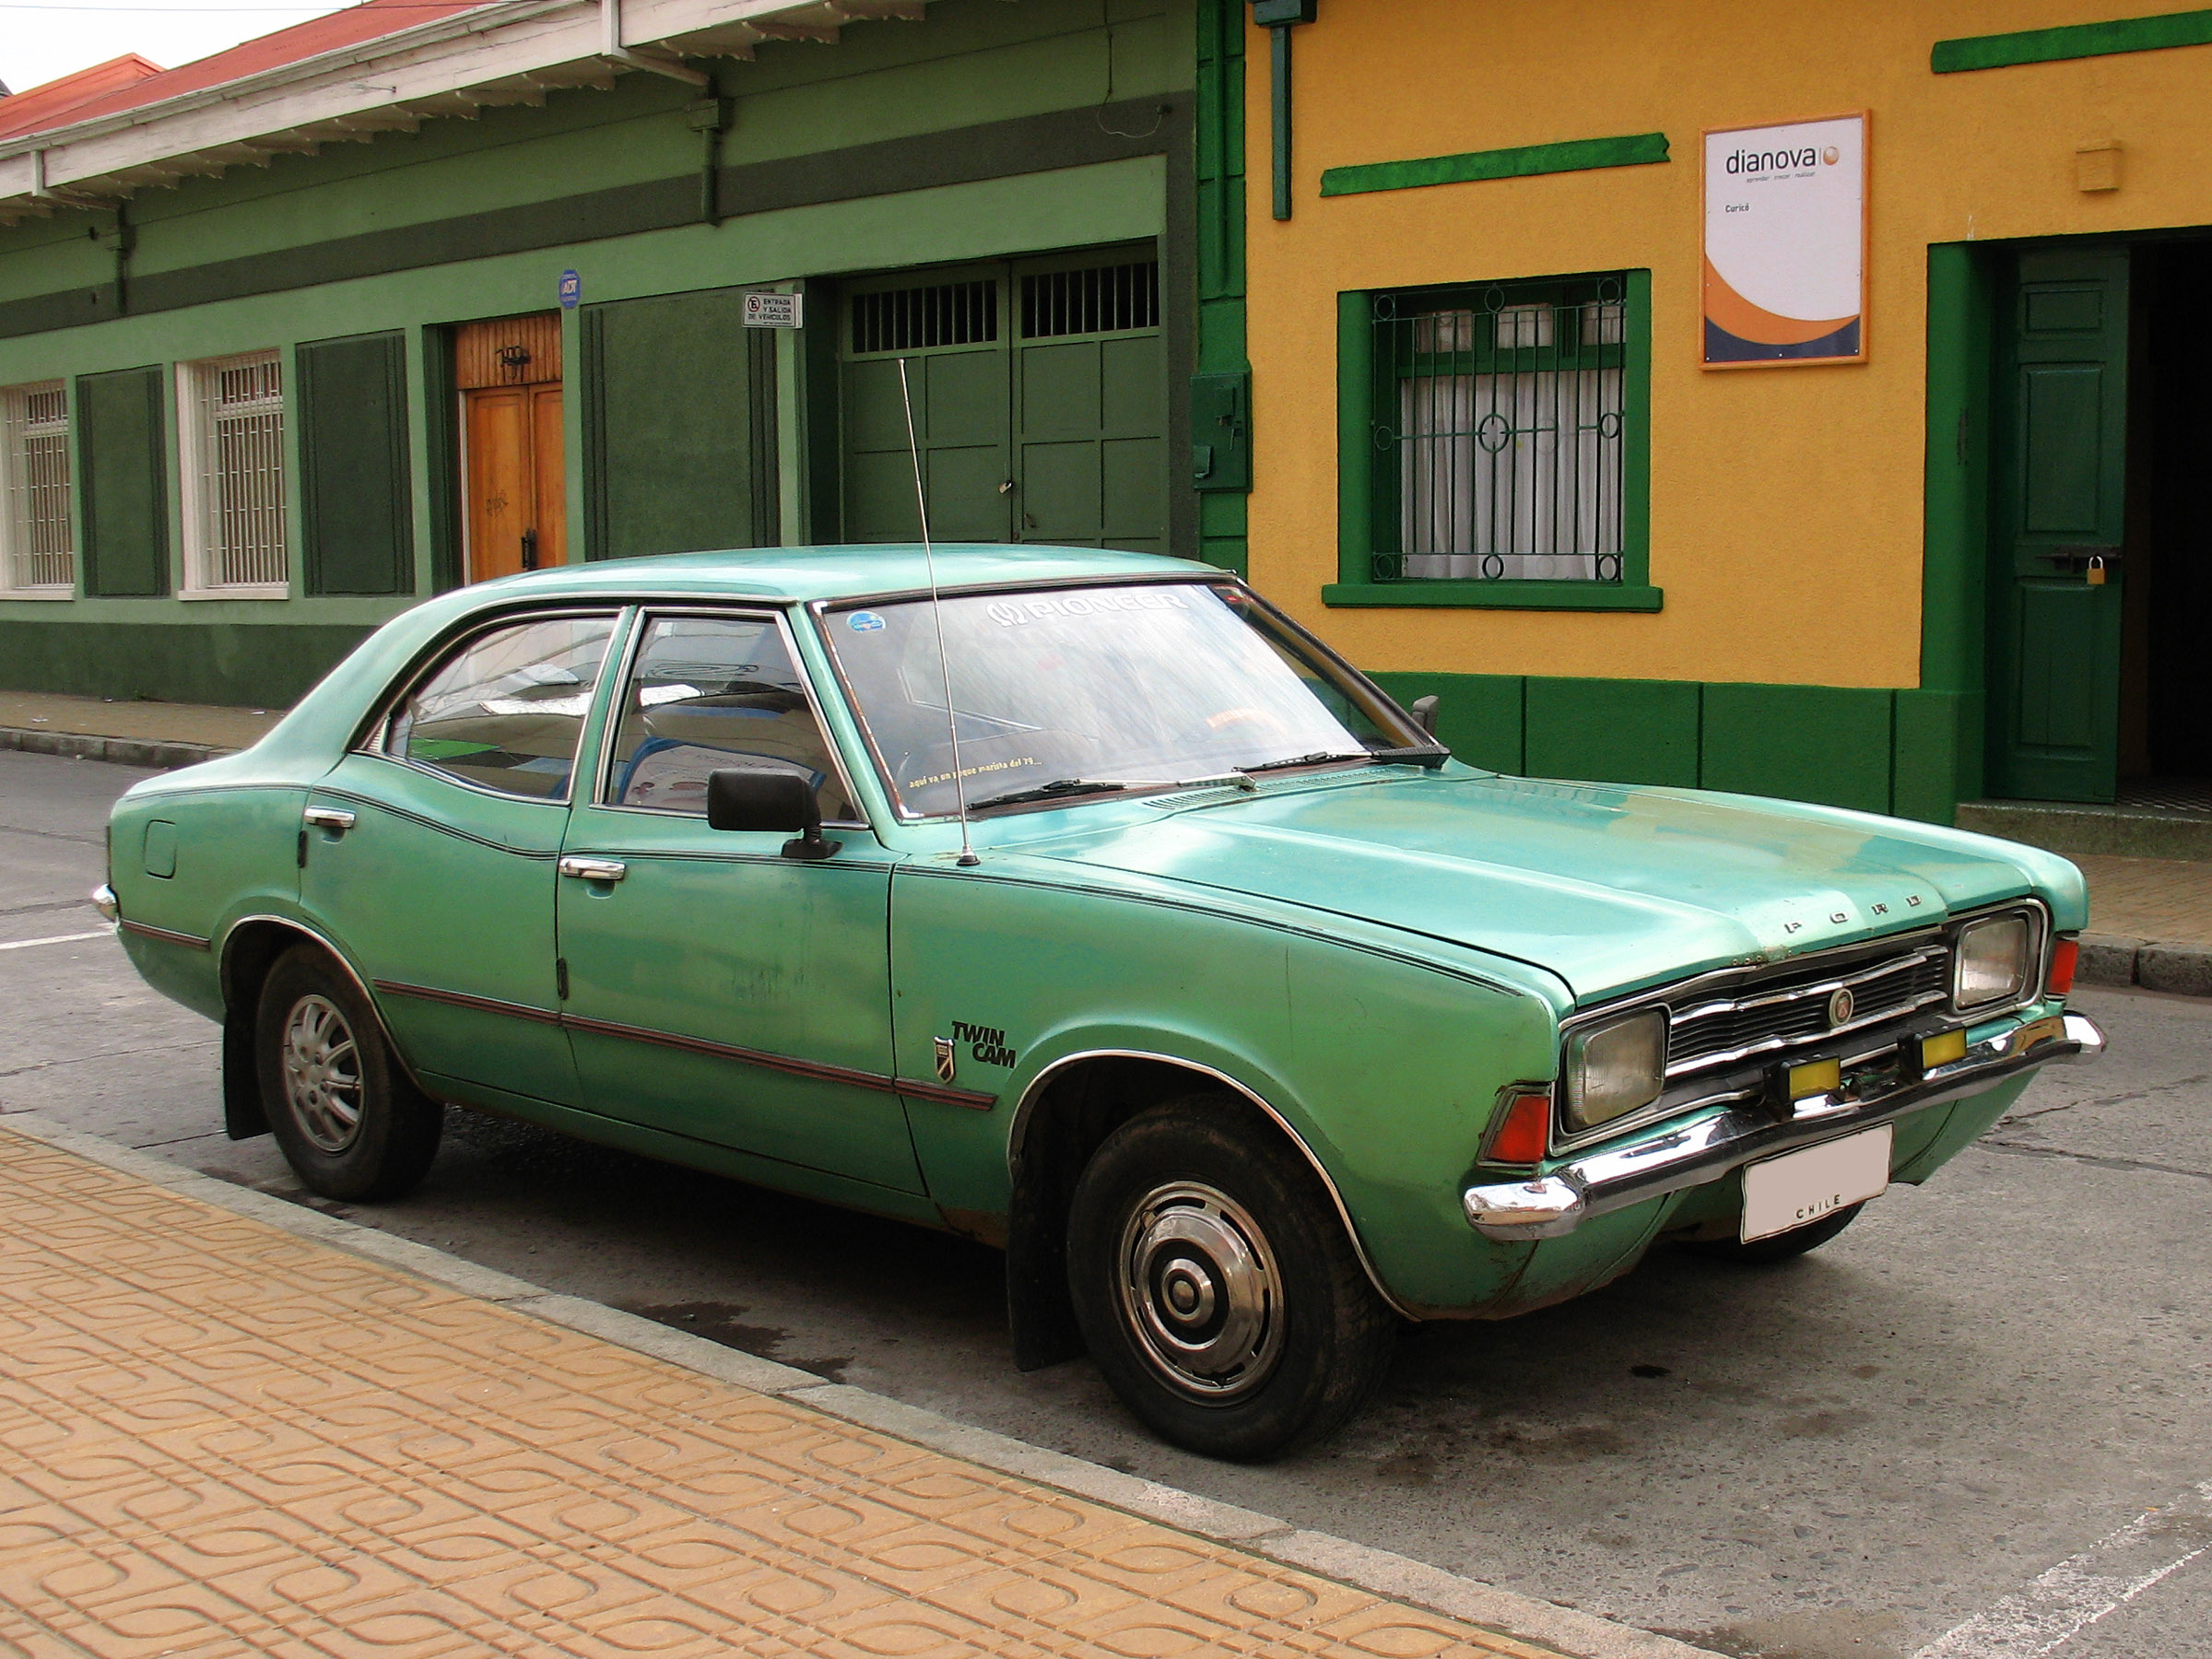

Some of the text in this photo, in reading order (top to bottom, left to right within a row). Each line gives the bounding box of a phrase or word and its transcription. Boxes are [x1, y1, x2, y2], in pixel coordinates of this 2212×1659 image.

[1725, 147, 1816, 174] dianova
[1725, 203, 1749, 213] Curicó
[1024, 594, 1189, 619] PIONEER
[940, 772, 951, 781] un
[952, 768, 977, 780] pque
[978, 761, 1008, 772] marista
[1009, 758, 1022, 768] del
[1784, 895, 1923, 934] FORD
[951, 1020, 1006, 1048] TWIN
[972, 1042, 1017, 1069] CAM
[1795, 1194, 1841, 1219] CHILE
